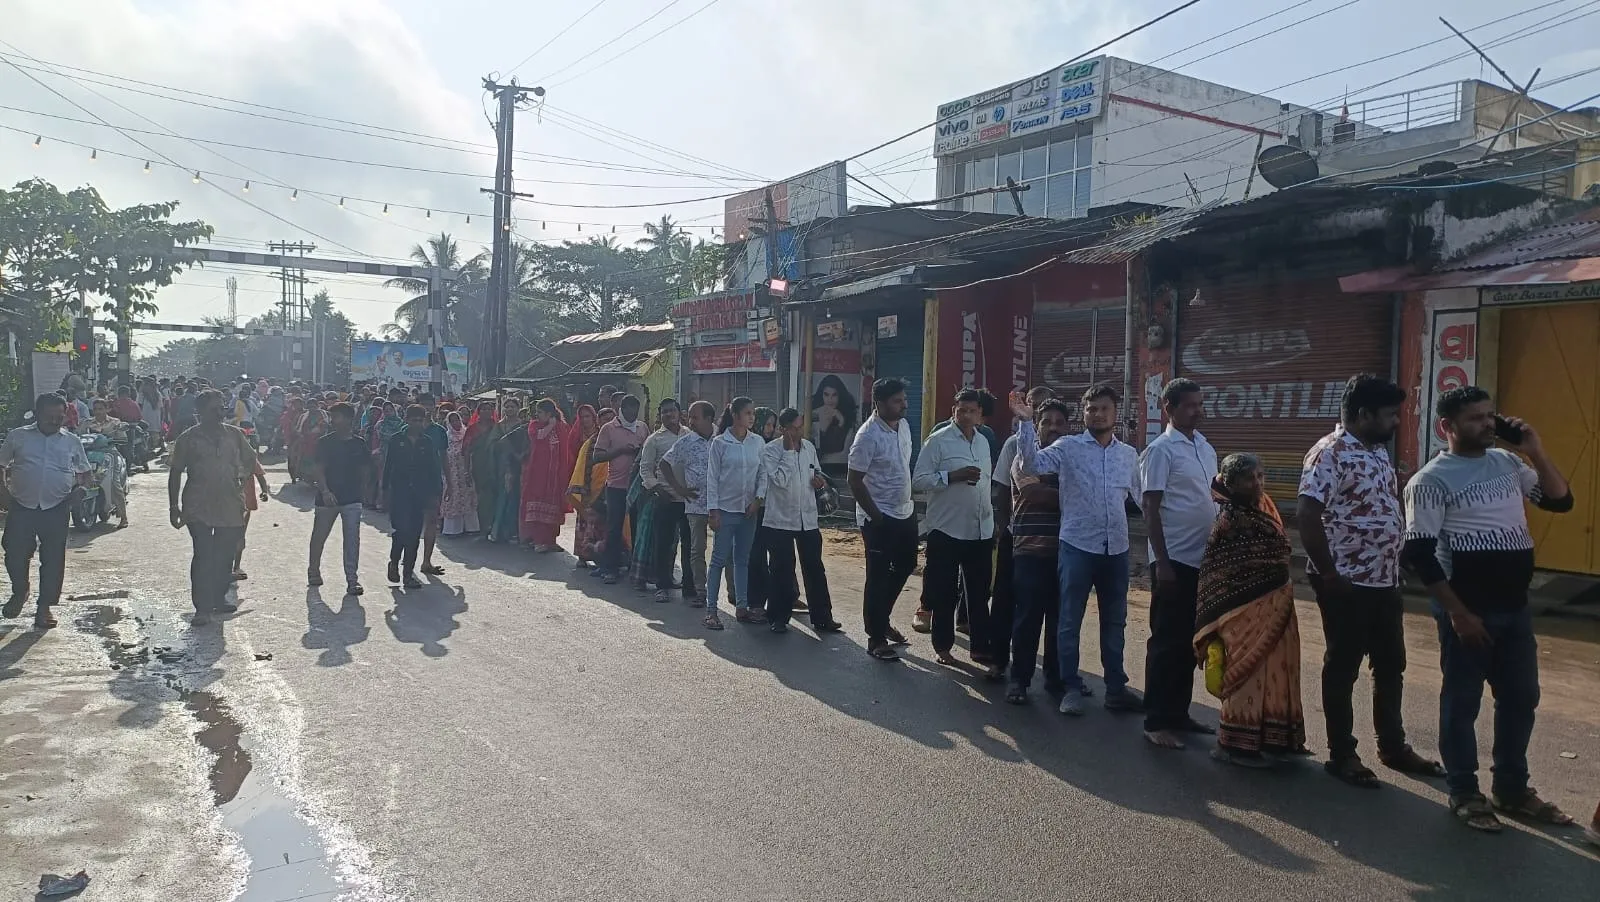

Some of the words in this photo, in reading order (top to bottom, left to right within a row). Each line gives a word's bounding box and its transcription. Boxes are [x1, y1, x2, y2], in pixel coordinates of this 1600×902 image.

[1062, 60, 1099, 82] acer
[1033, 76, 1049, 92] LG
[1061, 81, 1094, 102] DELL
[938, 119, 969, 137] vivo
[1012, 314, 1028, 393] NTLINE
